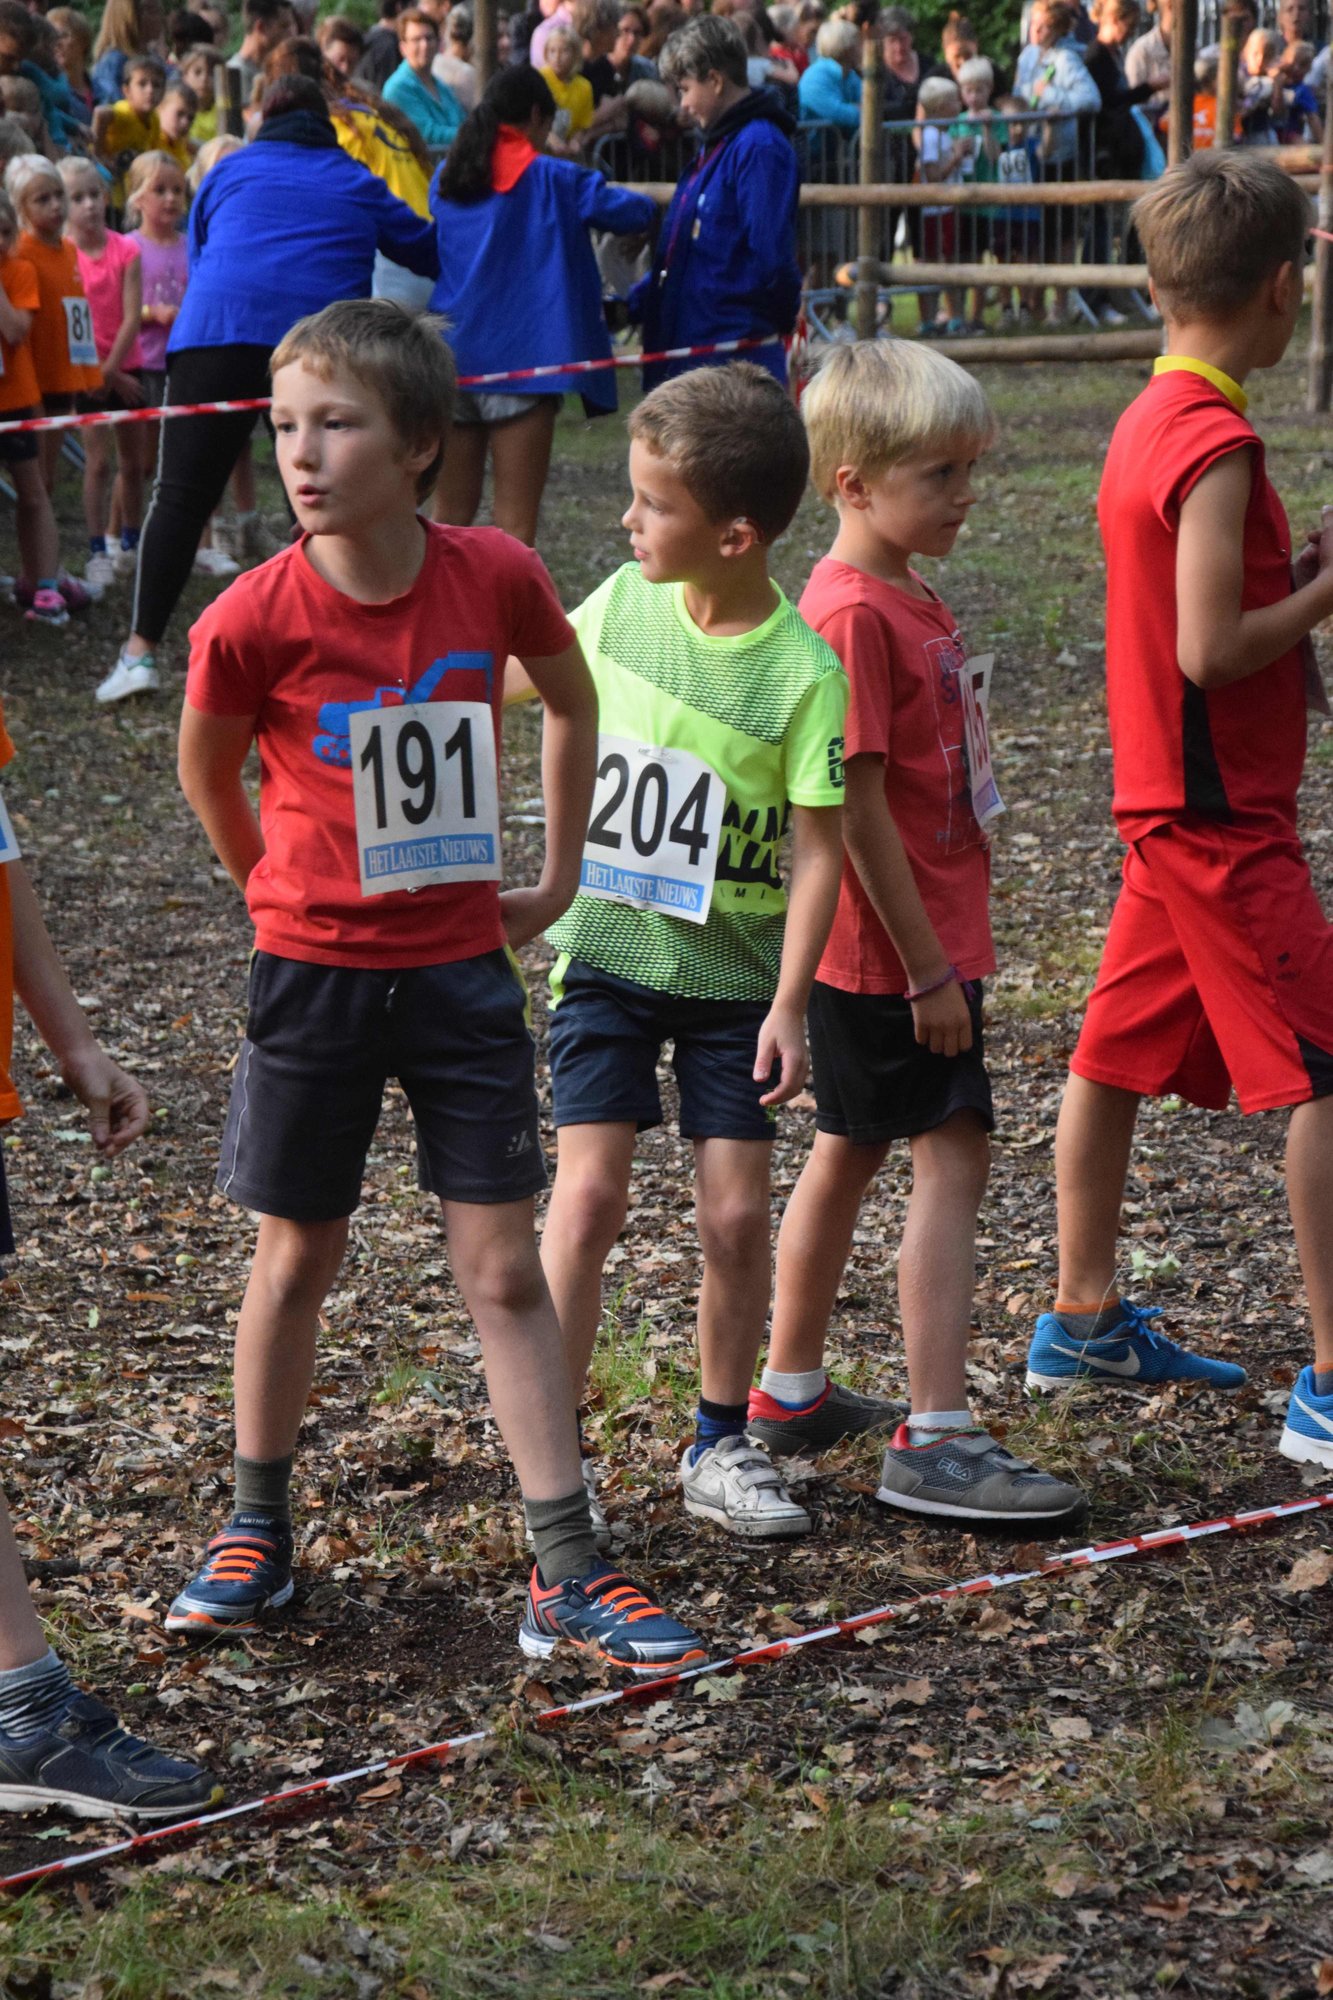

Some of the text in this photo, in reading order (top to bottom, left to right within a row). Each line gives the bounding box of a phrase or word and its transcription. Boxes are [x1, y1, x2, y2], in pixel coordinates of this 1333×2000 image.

[72, 304, 92, 341] 81
[360, 717, 476, 829] 191
[586, 753, 711, 866] 204
[368, 838, 489, 875] HET LAATSTE NIEUWS
[586, 862, 699, 909] HET LAATSTE NIEUWS
[937, 1456, 971, 1481] FILA
